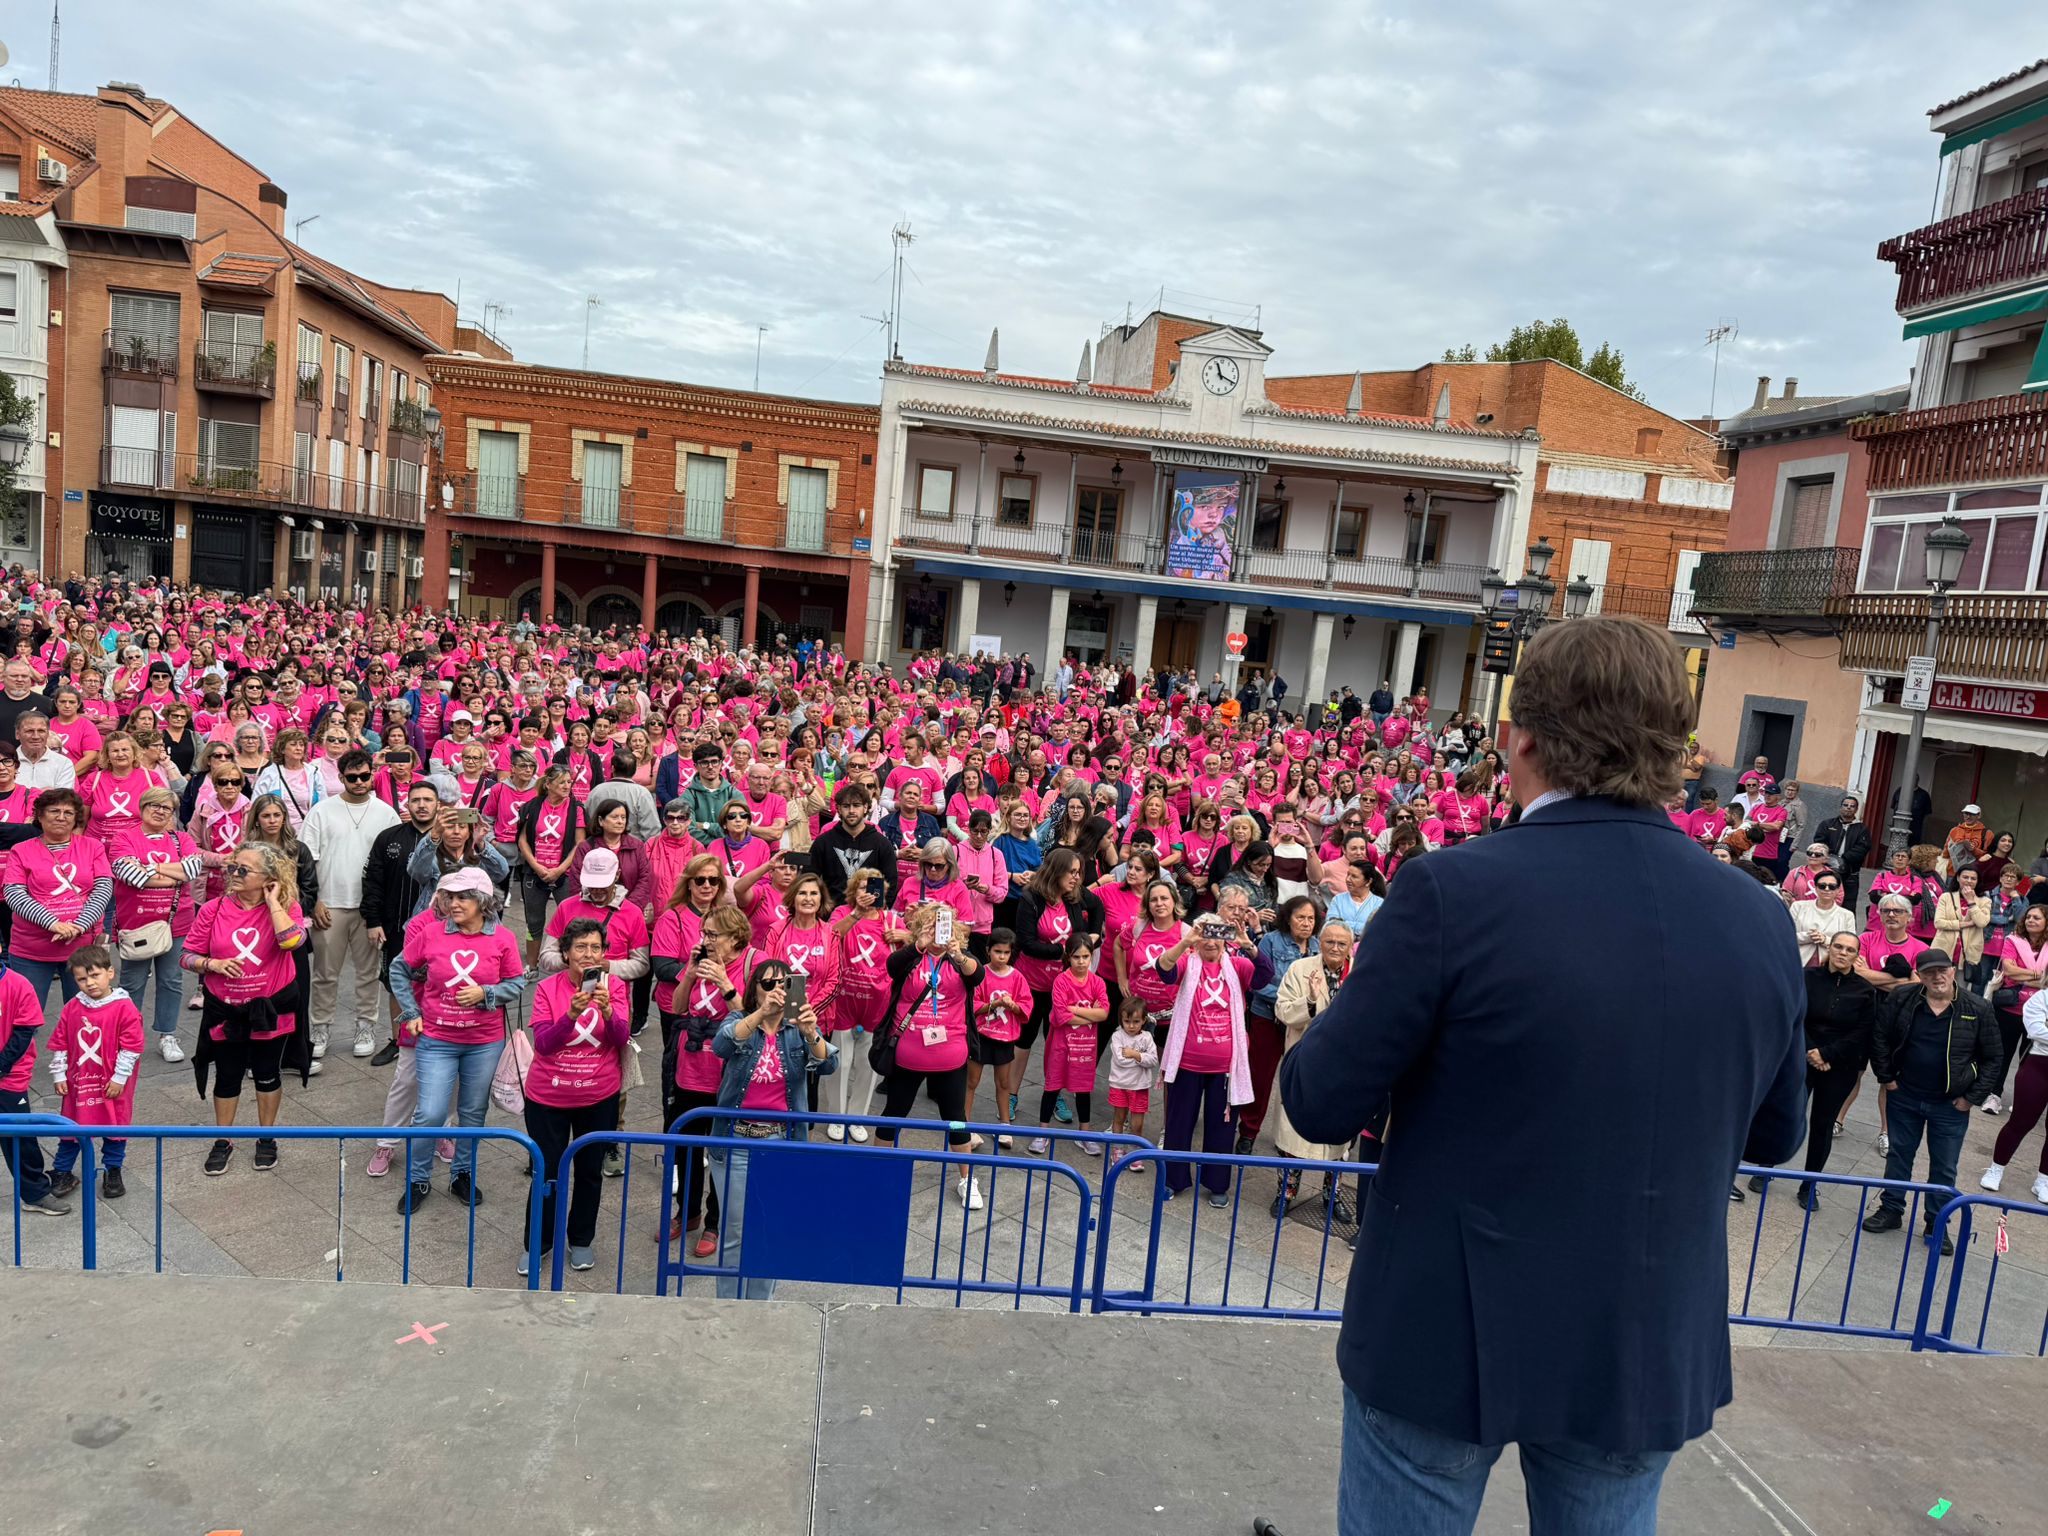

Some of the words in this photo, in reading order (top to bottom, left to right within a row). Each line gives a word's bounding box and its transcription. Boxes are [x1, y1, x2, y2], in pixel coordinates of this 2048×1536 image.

[1154, 447, 1267, 471] AYUNTAMIENTO
[97, 504, 161, 522] COYOTE
[1935, 684, 1967, 708] C.R.
[1970, 687, 2036, 715] HOMES
